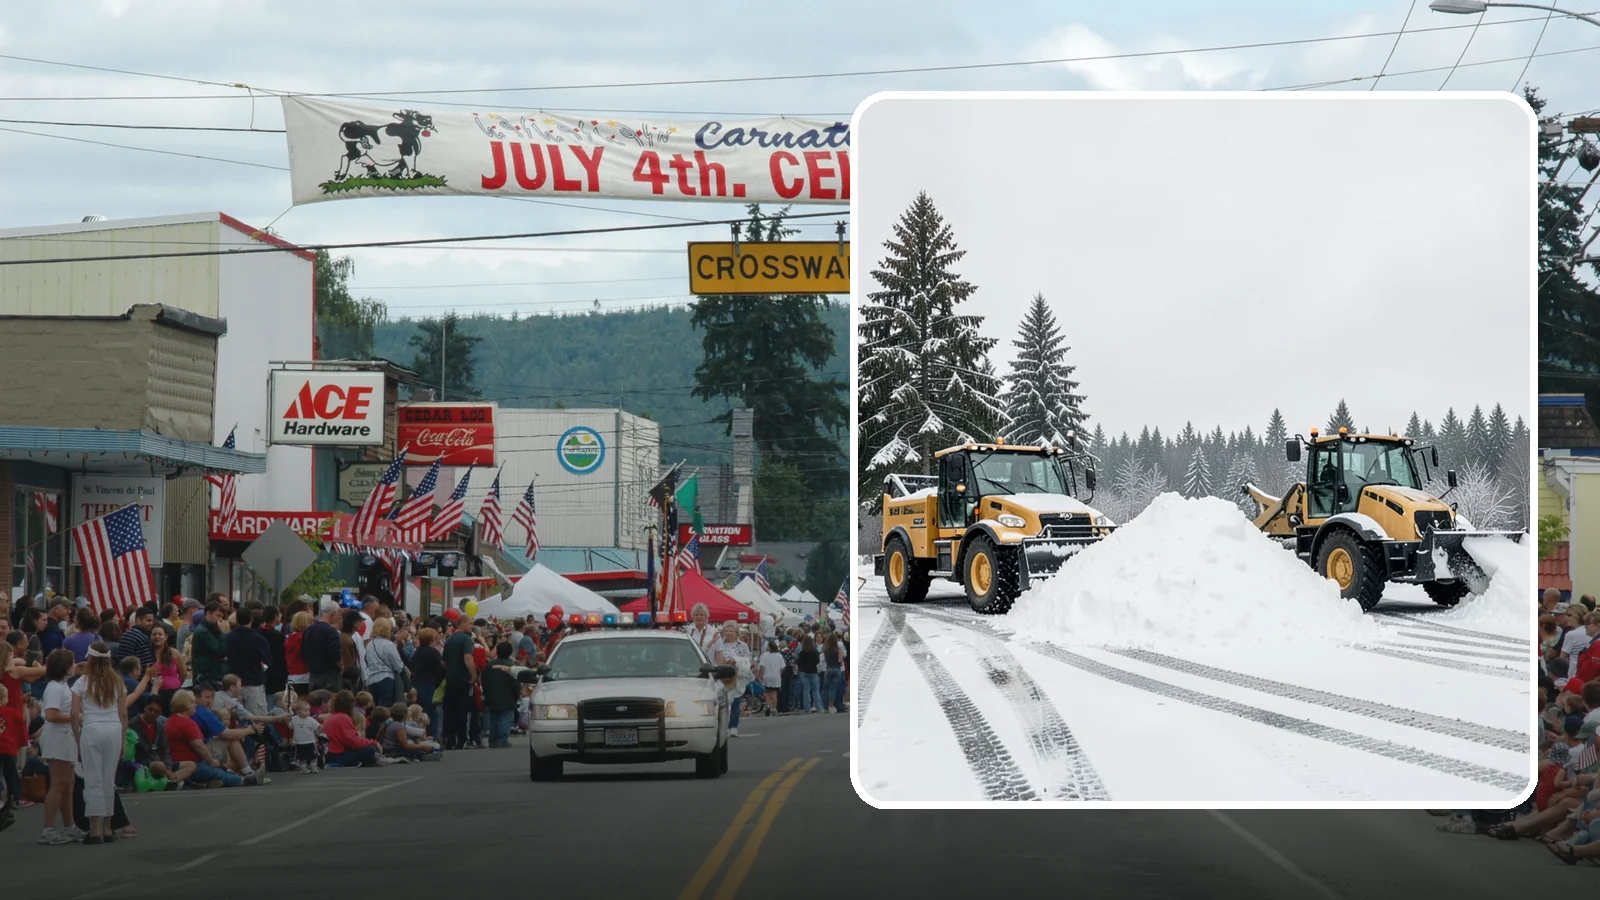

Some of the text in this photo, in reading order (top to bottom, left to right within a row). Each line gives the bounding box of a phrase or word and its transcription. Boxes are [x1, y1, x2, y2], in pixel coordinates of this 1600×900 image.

[481, 141, 605, 192] JULY
[632, 150, 747, 198] 4th.
[696, 254, 850, 281] CROSSWA
[283, 380, 373, 420] ACE
[405, 408, 453, 422] CEDAR
[283, 421, 370, 436] Hardware
[416, 427, 477, 447] Coca-Cola
[353, 467, 386, 481] Simpl
[96, 485, 124, 495] Vincent
[126, 485, 136, 495] de
[137, 486, 155, 496] Paul
[699, 535, 730, 543] GLASS
